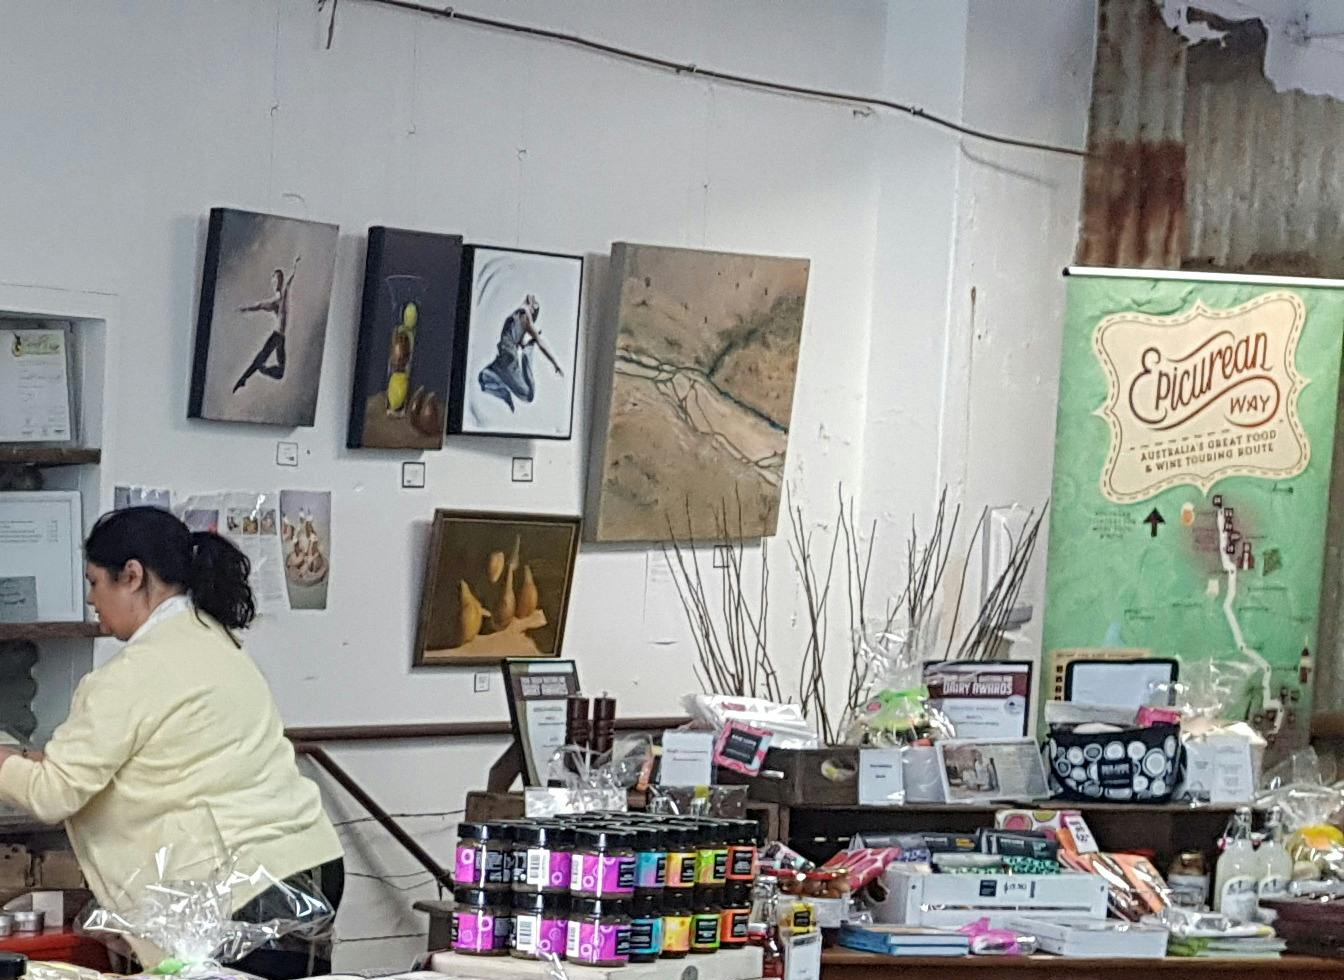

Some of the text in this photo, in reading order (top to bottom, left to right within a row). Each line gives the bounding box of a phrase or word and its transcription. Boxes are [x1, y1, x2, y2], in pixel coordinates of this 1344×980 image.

[1129, 331, 1272, 424] Epicurean
[1230, 395, 1270, 415] WAY
[1141, 430, 1276, 461] AUSTRALIA'S GREAT FOOD
[1156, 457, 1182, 471] WINE
[1186, 450, 1233, 464] TOURING
[1238, 445, 1274, 456] ROUTE
[943, 681, 1012, 695] DAIRY AWARDS
